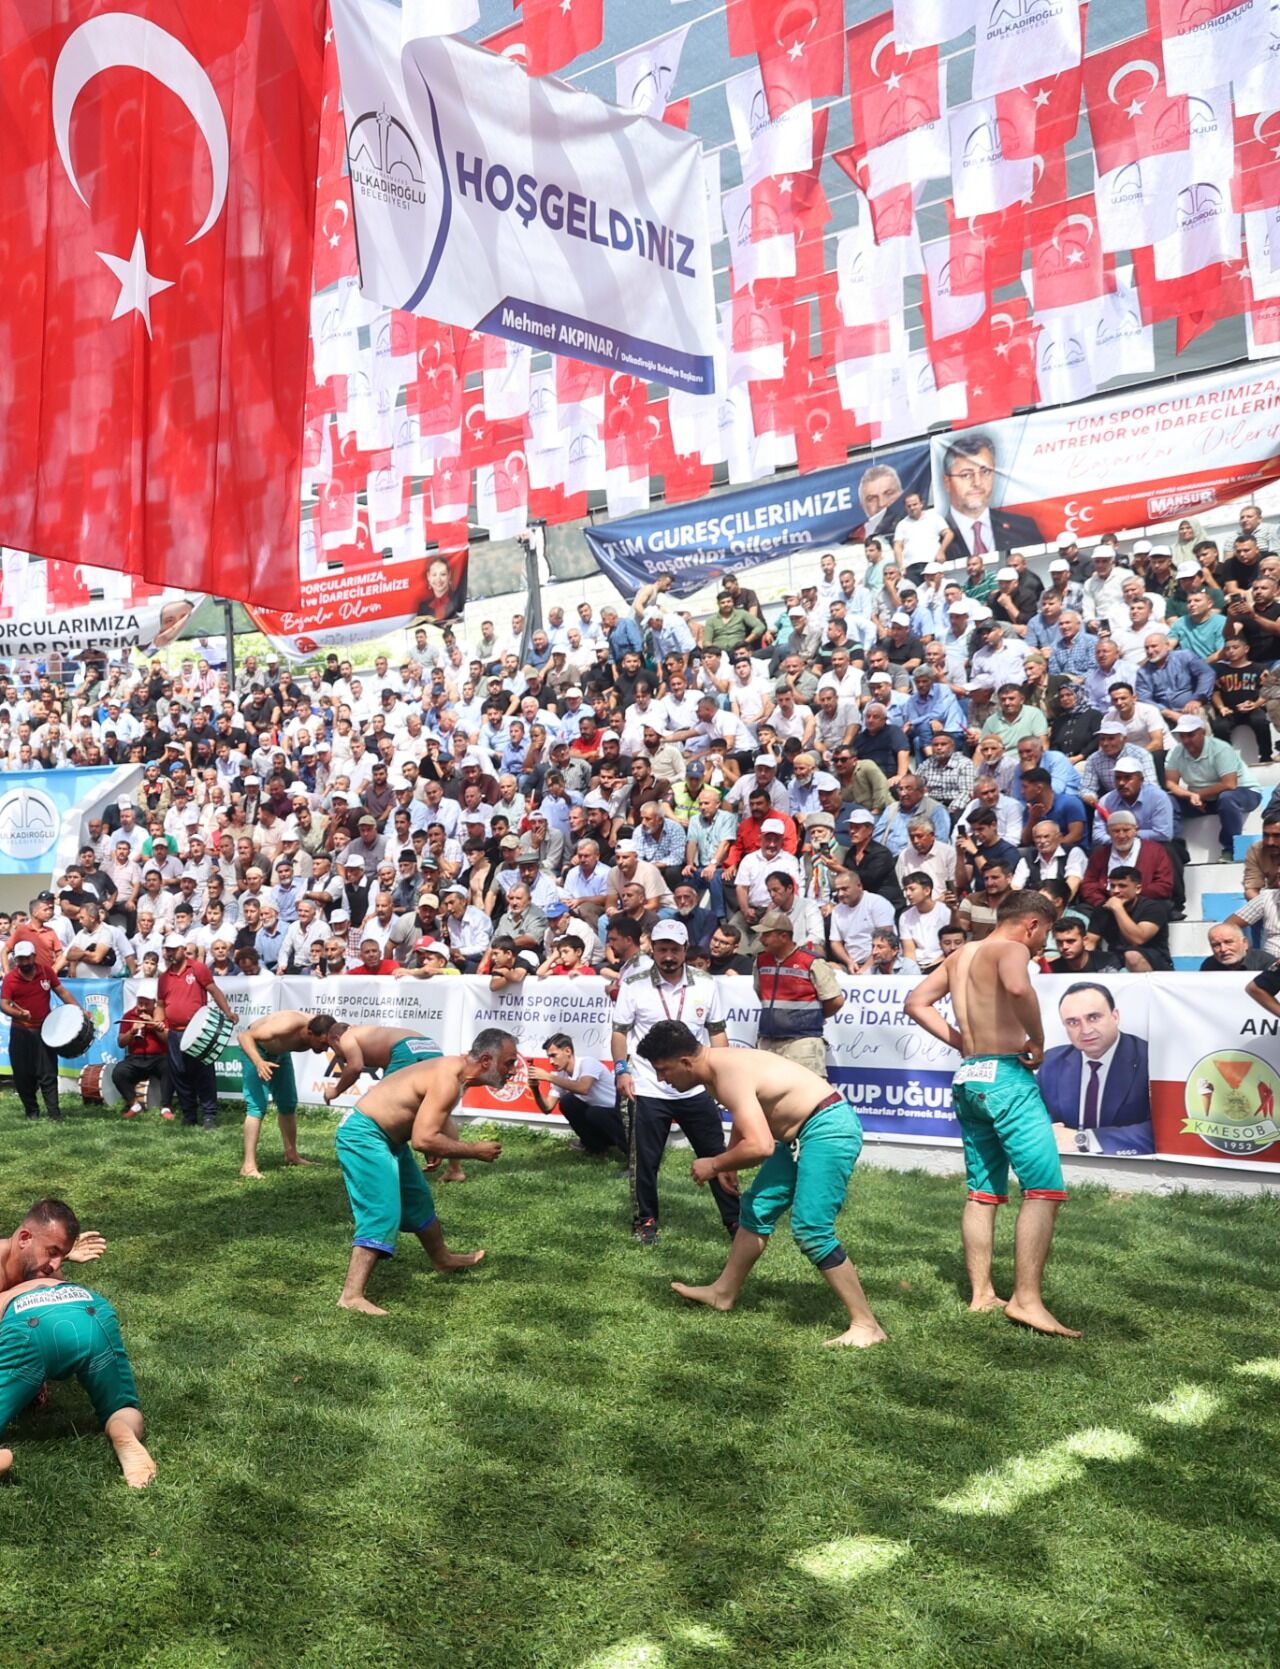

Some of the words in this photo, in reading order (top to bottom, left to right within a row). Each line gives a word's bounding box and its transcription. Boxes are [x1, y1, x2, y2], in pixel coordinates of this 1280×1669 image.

[455, 151, 696, 278] HOŞGELDİNİZ
[501, 308, 557, 340] Mehmet
[558, 325, 614, 359] AKPINAR
[1067, 416, 1105, 432] TÜM
[1033, 427, 1127, 456] ANTRENÖR
[1131, 425, 1150, 437] ve
[730, 528, 813, 555] Dilerim
[315, 994, 336, 1005] TÜM
[498, 993, 524, 1006] TÜM
[348, 1010, 359, 1018] ve
[360, 1007, 444, 1020] İDARECİLERİMİZE
[474, 1009, 541, 1022] ANTRENÖR
[543, 1013, 556, 1023] ve
[833, 1013, 855, 1025] ve
[896, 1107, 934, 1119] Dernek
[1193, 1121, 1266, 1139] KMESOB
[1223, 1141, 1253, 1151] 1952
